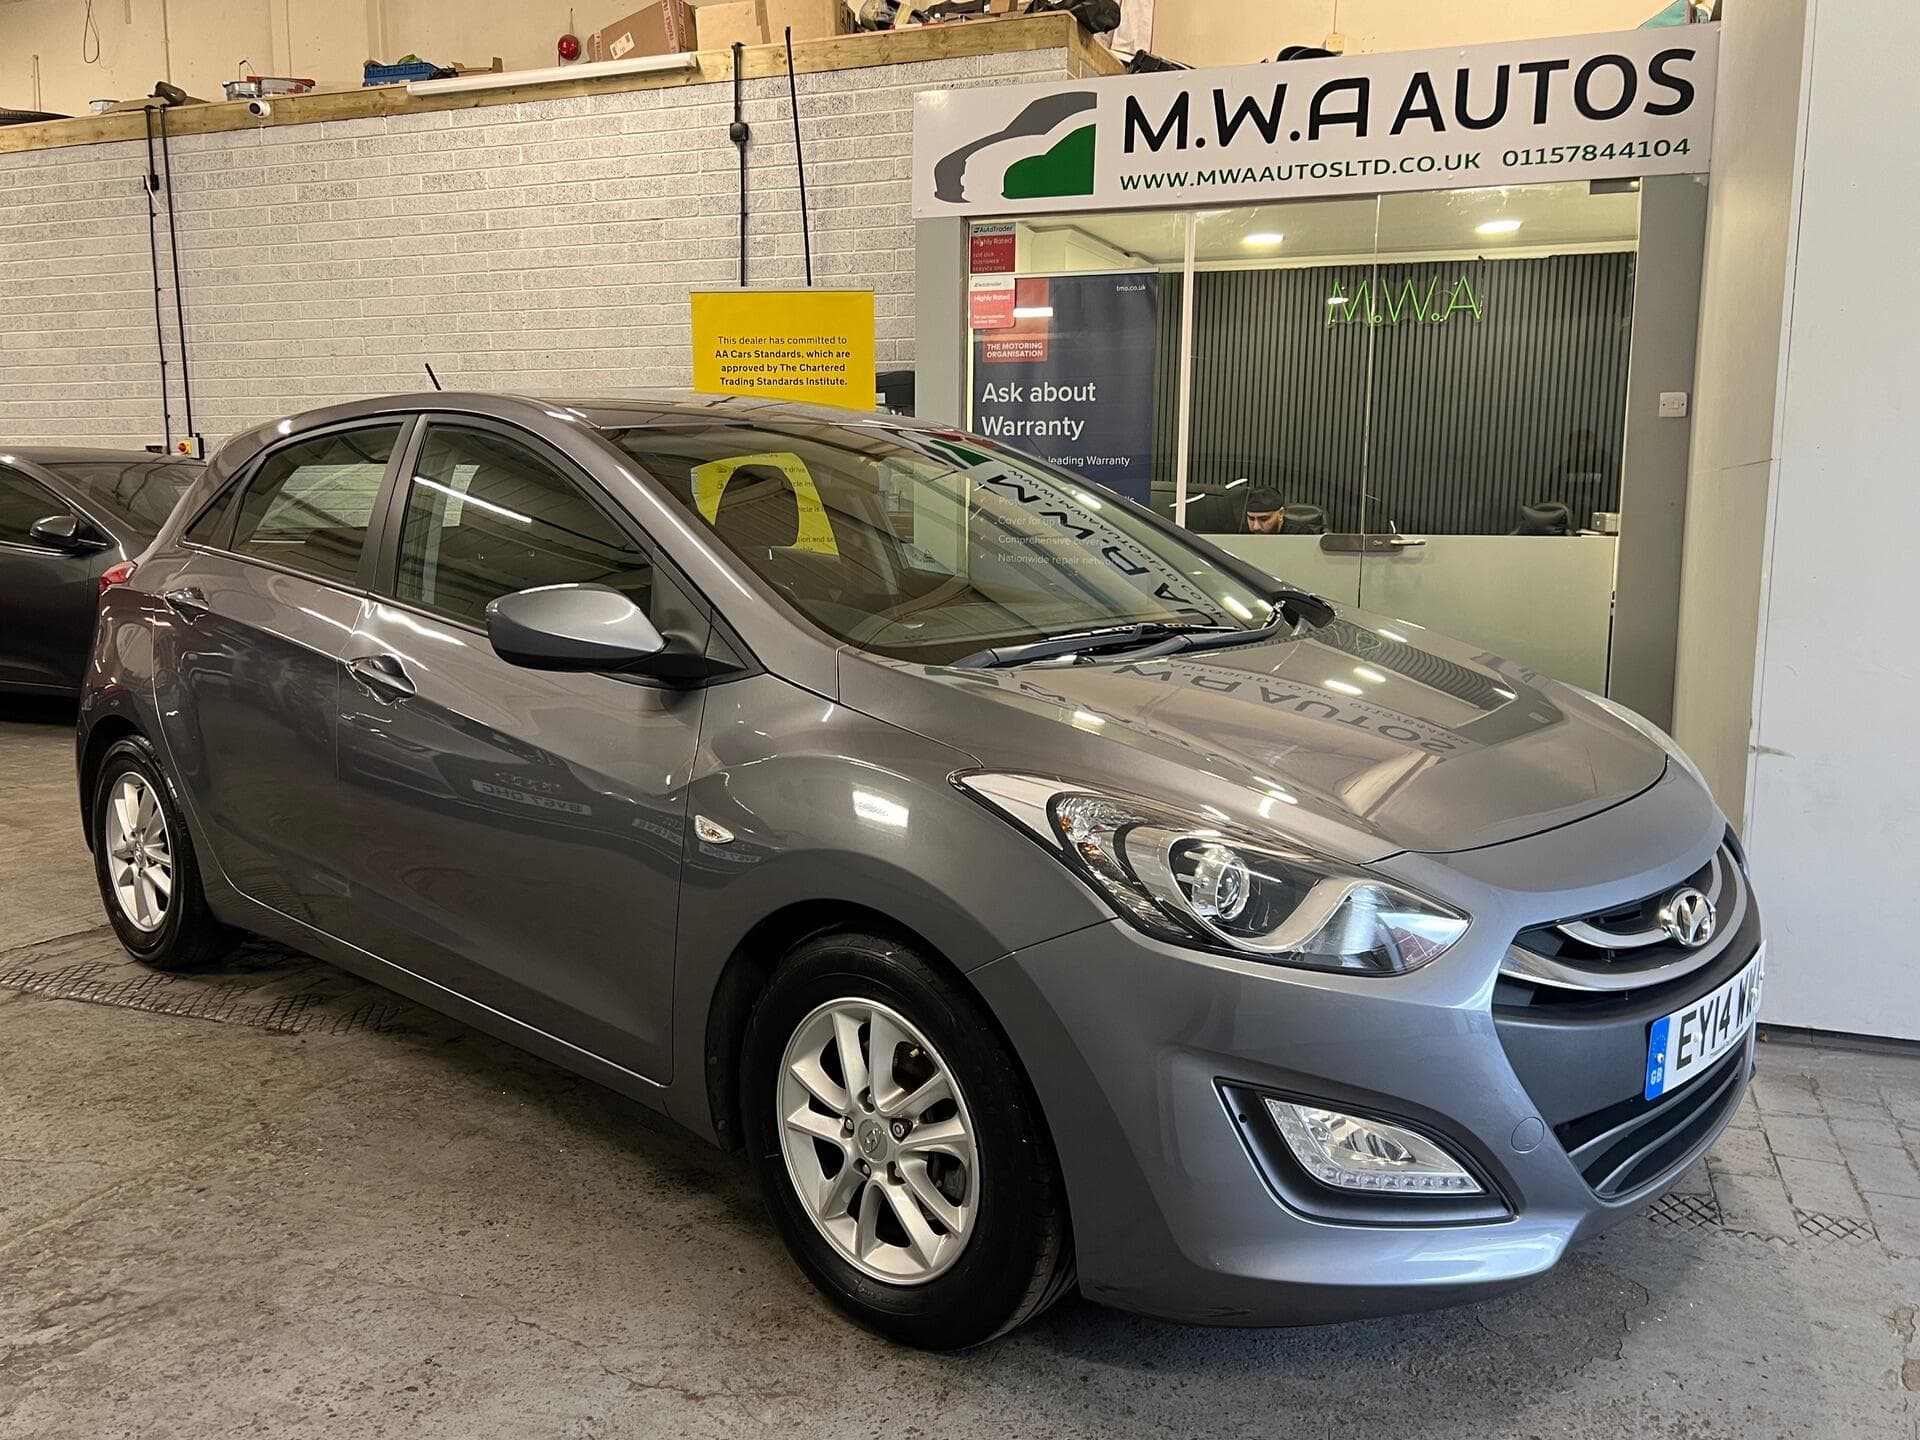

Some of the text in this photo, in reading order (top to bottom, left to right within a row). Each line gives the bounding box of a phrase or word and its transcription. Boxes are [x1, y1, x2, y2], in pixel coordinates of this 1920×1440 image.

[1124, 48, 1696, 153] M.W.A AUTOS
[1120, 138, 1690, 190] WWW.MWAAUTOSLTD.CO.UK 01157844104
[1116, 284, 1146, 292] tmo.co.uk
[1328, 275, 1480, 325] M.W.A
[718, 336, 737, 345] This
[739, 336, 766, 344] dealer
[769, 336, 785, 344] has
[787, 336, 835, 344] committed
[731, 350, 752, 358] Cars
[755, 350, 804, 359] Standards,
[806, 350, 833, 358] which
[987, 350, 1043, 358] ORGANISATION
[721, 364, 845, 373] approved by The Chartered
[720, 377, 754, 387] Trading
[757, 377, 804, 385] Standards
[982, 382, 1096, 403] Ask about
[981, 416, 1084, 441] Warranty
[1086, 456, 1130, 467] Warranty
[998, 517, 1025, 525] Cover
[1029, 516, 1040, 525] for
[1042, 519, 1054, 528] up
[998, 535, 1070, 545] Comprehensive
[998, 554, 1049, 564] Nationwide
[1052, 556, 1079, 566] repair
[1676, 987, 1733, 1072] EY14
[1651, 1066, 1663, 1085] GB
